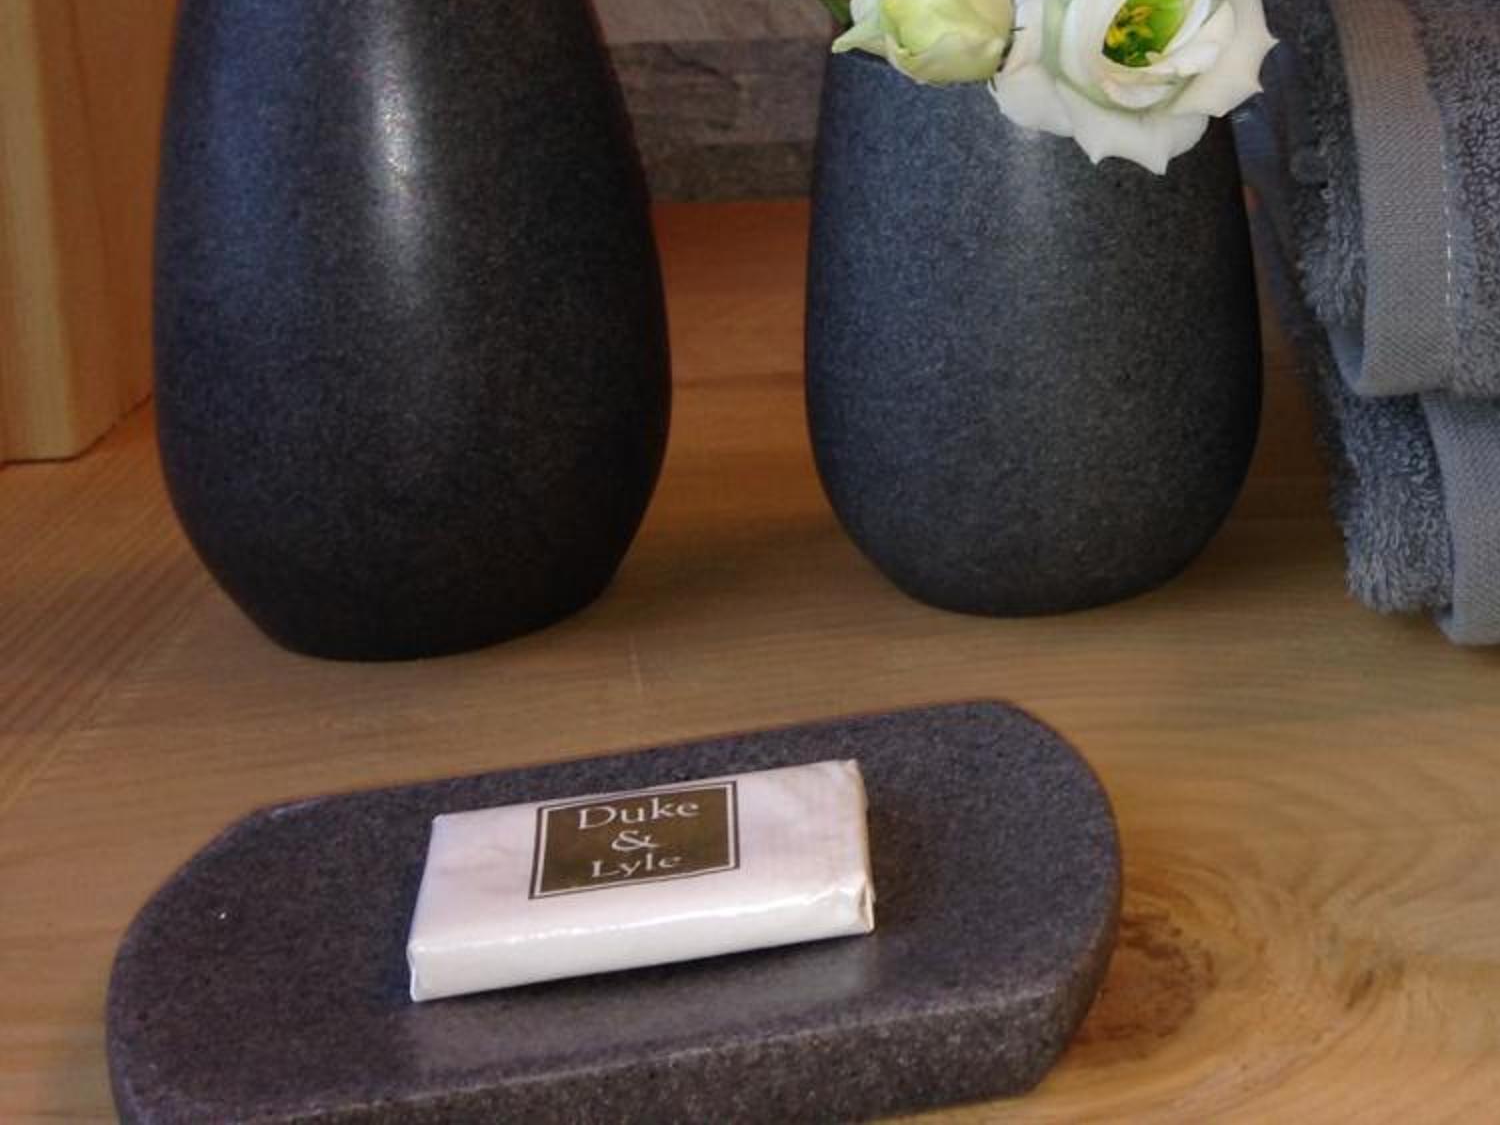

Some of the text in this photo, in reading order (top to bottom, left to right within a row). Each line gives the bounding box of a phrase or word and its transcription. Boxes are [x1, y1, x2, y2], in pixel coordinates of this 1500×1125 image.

[578, 796, 700, 831] Duke
[610, 829, 660, 852] &
[591, 851, 683, 879] Lyle
